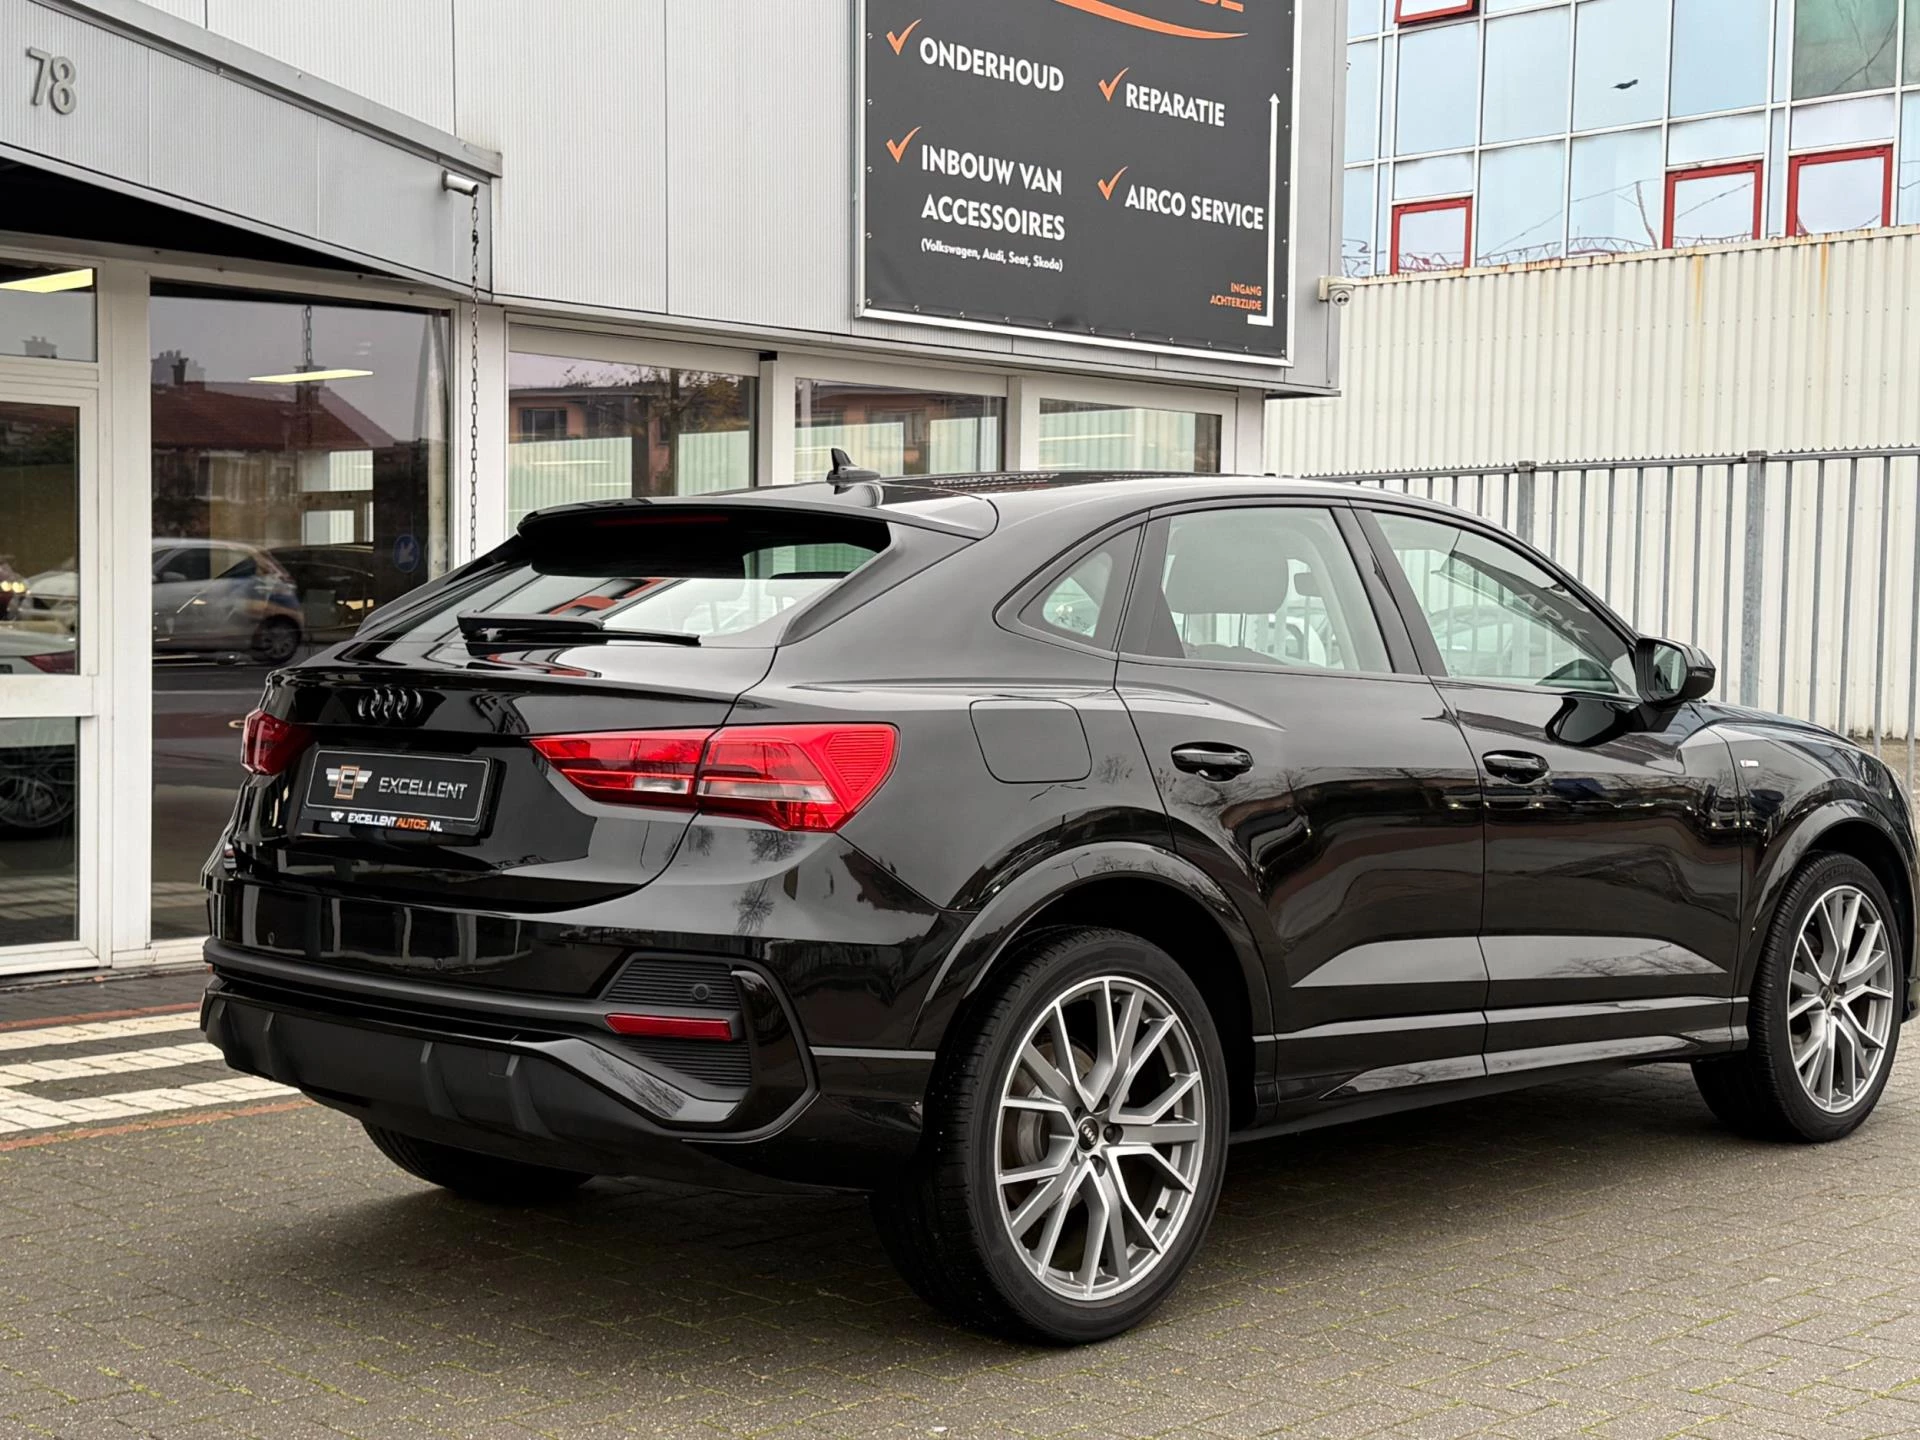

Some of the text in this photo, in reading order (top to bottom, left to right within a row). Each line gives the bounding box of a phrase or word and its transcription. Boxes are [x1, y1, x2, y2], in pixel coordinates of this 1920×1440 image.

[25, 47, 77, 115] 78
[919, 37, 1065, 92] ONDERHOUD
[1125, 83, 1226, 127] REPARATIE
[921, 144, 1063, 195] INBOUW VAN
[921, 194, 1066, 241] ACCESSOIRES
[1124, 184, 1264, 231] AIRCO SERVICE
[920, 238, 1063, 272] (Volkswagen, Audi, Seat, Skoda)
[1230, 282, 1262, 297] INGANG
[378, 776, 468, 800] EXCELLENT
[347, 812, 443, 833] EXCELLENTAUTOS.NL
